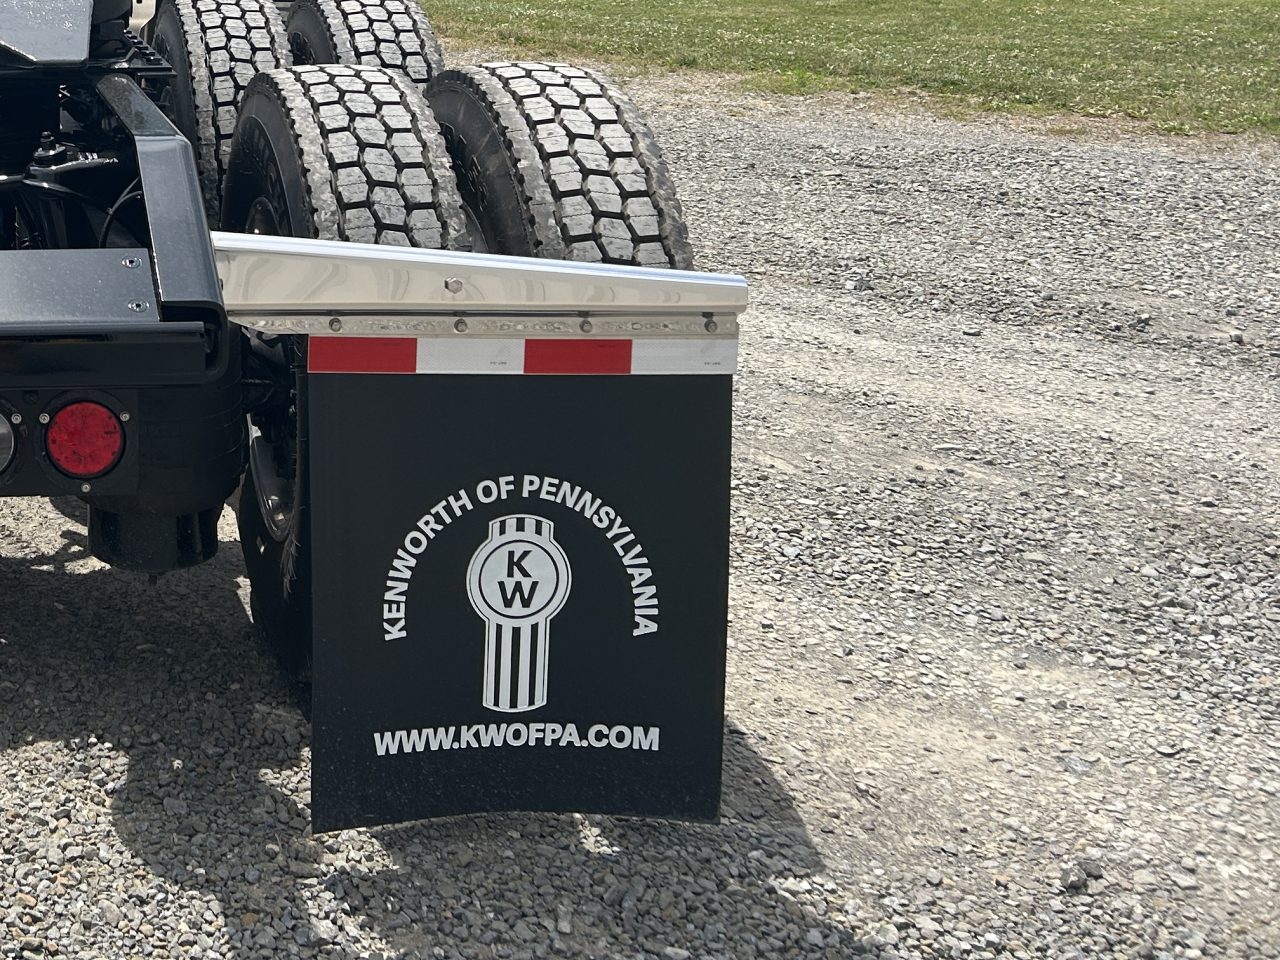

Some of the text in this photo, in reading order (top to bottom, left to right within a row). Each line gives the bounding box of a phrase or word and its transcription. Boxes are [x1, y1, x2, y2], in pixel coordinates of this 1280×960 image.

[382, 474, 659, 641] KENWORTH OF PENNSYLVANIA
[373, 722, 660, 756] WWW.KWOFPA.COM
